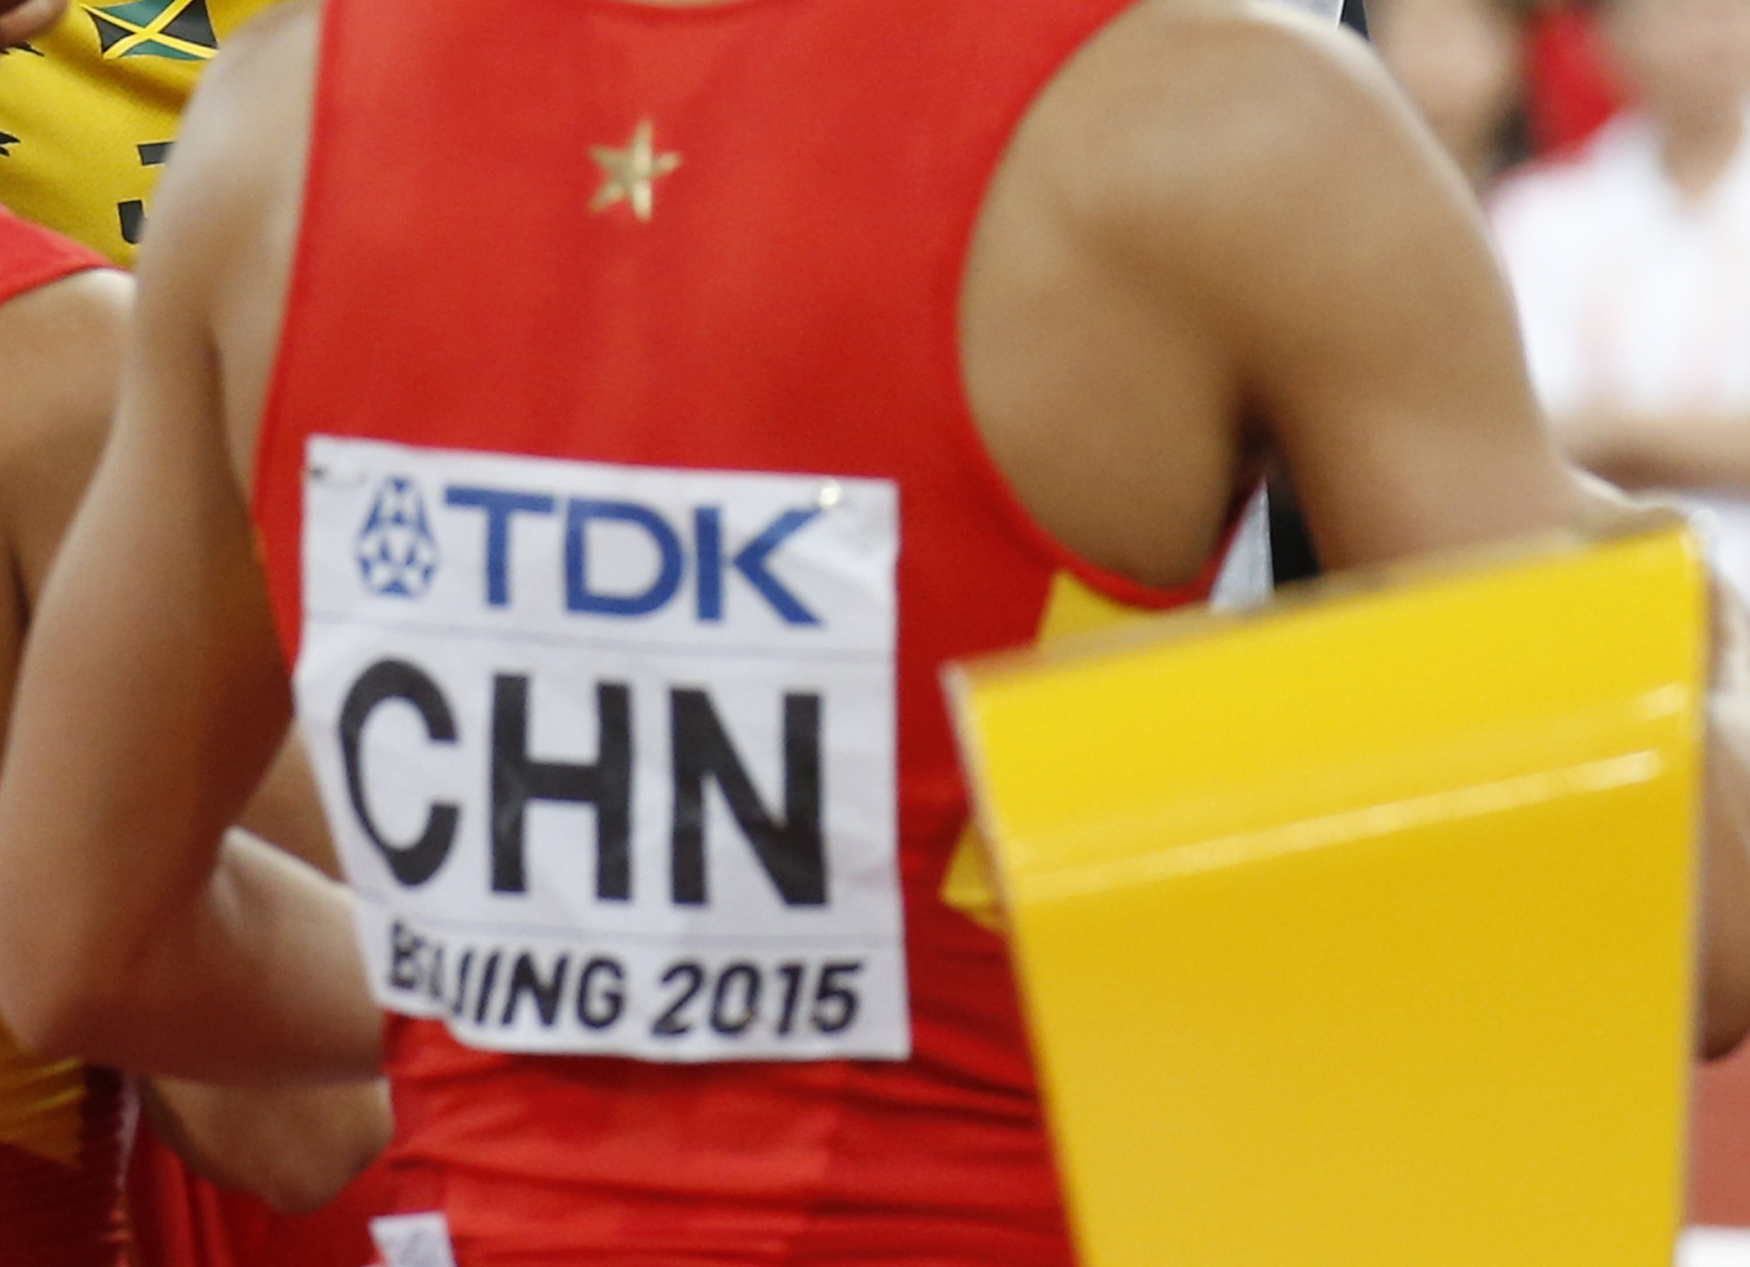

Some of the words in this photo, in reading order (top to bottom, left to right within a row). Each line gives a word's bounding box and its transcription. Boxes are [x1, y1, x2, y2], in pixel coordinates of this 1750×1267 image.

[443, 485, 828, 626] TDK
[338, 658, 829, 907] CHN
[652, 960, 865, 1036] 2015
